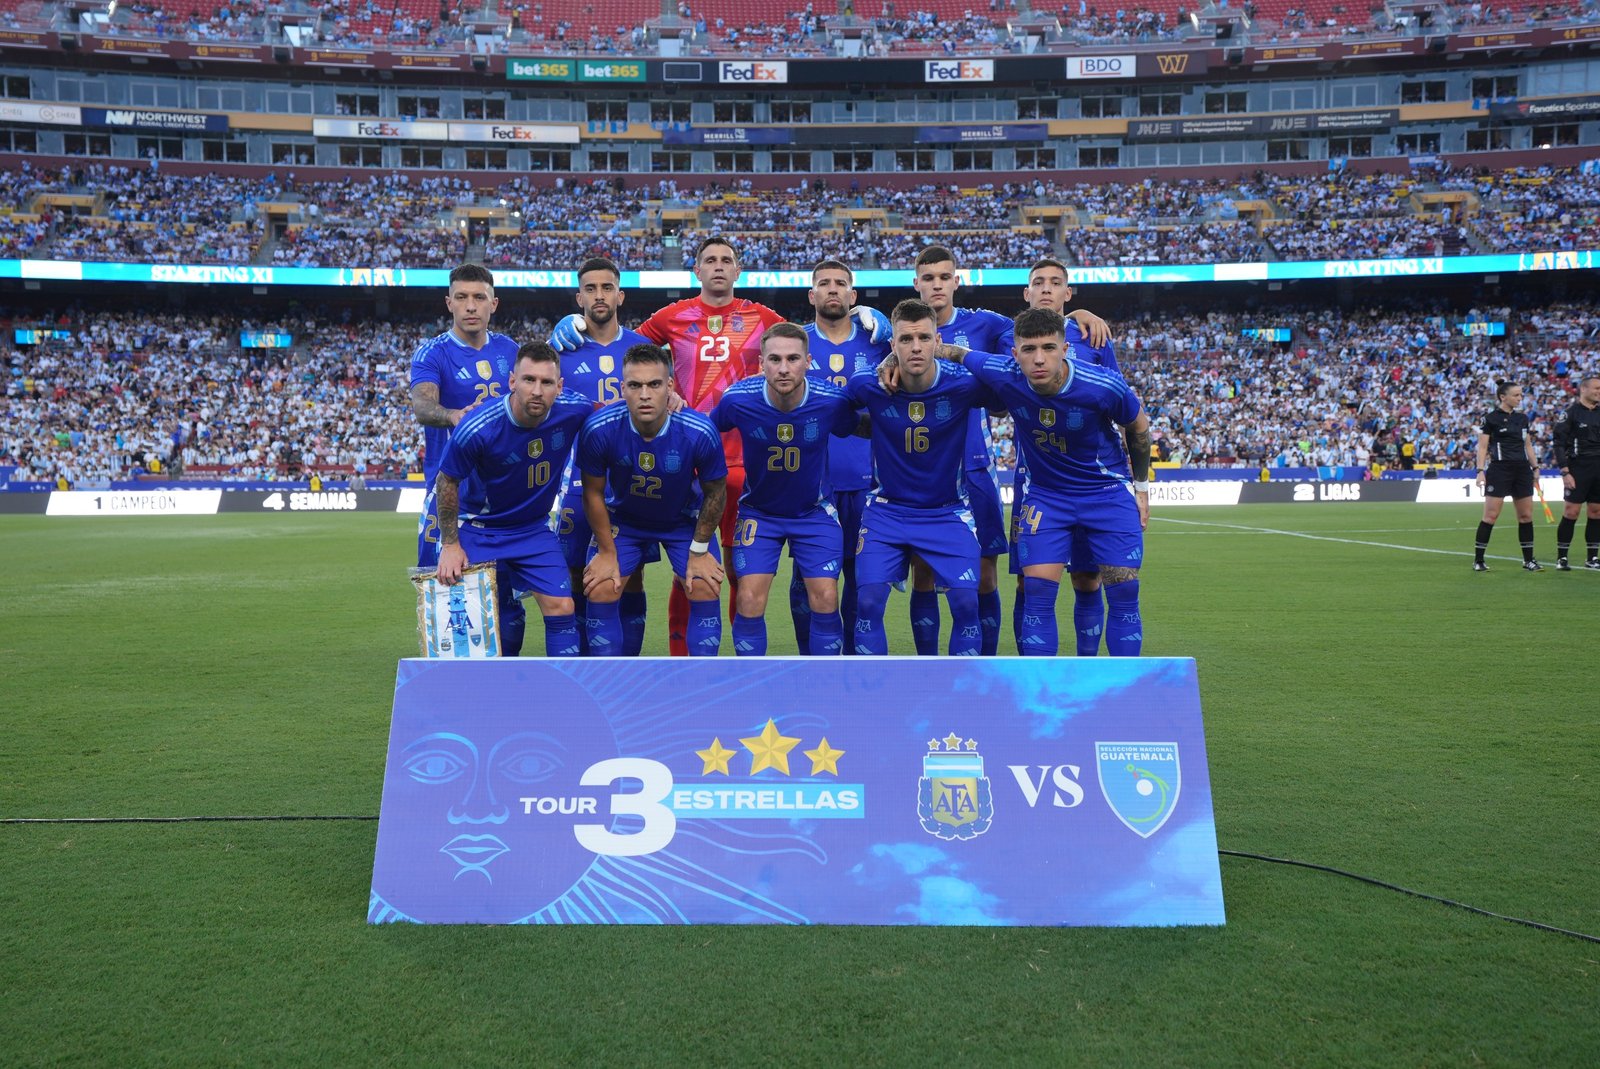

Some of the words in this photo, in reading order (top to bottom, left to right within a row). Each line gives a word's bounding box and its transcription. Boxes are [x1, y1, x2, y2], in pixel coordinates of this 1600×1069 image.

[513, 62, 569, 77] bet365
[584, 64, 639, 78] bet365
[723, 64, 776, 80] FedEx
[929, 62, 983, 79] FedEx
[1085, 59, 1122, 72] BDO
[1529, 104, 1565, 114] Fanatics
[136, 112, 207, 124] NORTHWEST
[358, 123, 399, 136] FedEx
[492, 127, 532, 140] FedEx
[152, 265, 248, 283] STARTING
[250, 267, 274, 283] XI
[1121, 266, 1142, 282] XI
[1324, 259, 1418, 276] STARTING
[1420, 258, 1443, 274] XI
[551, 271, 572, 288] XI
[700, 336, 730, 362] 23
[598, 378, 621, 402] 15
[905, 427, 930, 453] 16
[1032, 430, 1067, 454] 24
[767, 446, 801, 472] 20
[527, 460, 551, 489] 10
[630, 475, 662, 499] 22
[1320, 483, 1361, 501] LIGAS
[94, 496, 102, 510] 1
[262, 492, 285, 511] 4
[290, 492, 357, 511] SEMANAS
[1100, 752, 1175, 761] GUATEMALA
[1007, 764, 1084, 808] VS
[519, 797, 597, 816] TOUR
[573, 757, 677, 856] 3
[673, 790, 859, 811] ESTRELLAS
